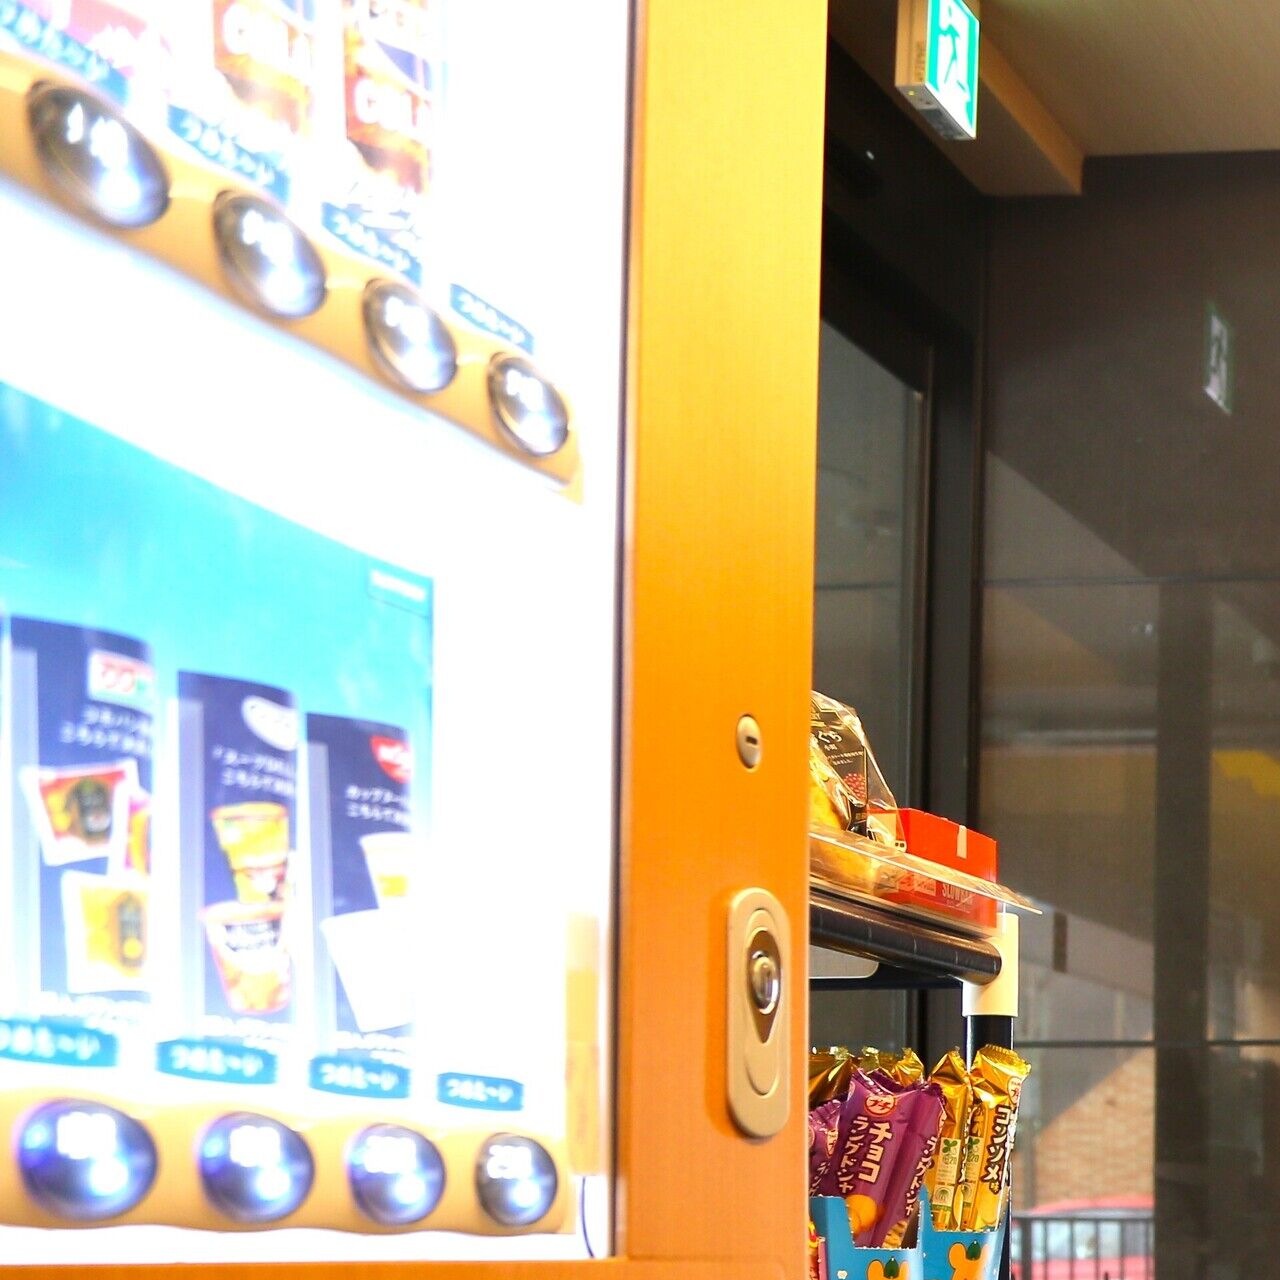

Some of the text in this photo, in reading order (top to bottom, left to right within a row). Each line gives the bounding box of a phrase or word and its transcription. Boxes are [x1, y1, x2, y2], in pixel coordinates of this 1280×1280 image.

[836, 1116, 869, 1195] ラングドシャ
[858, 1121, 893, 1184] チョコ
